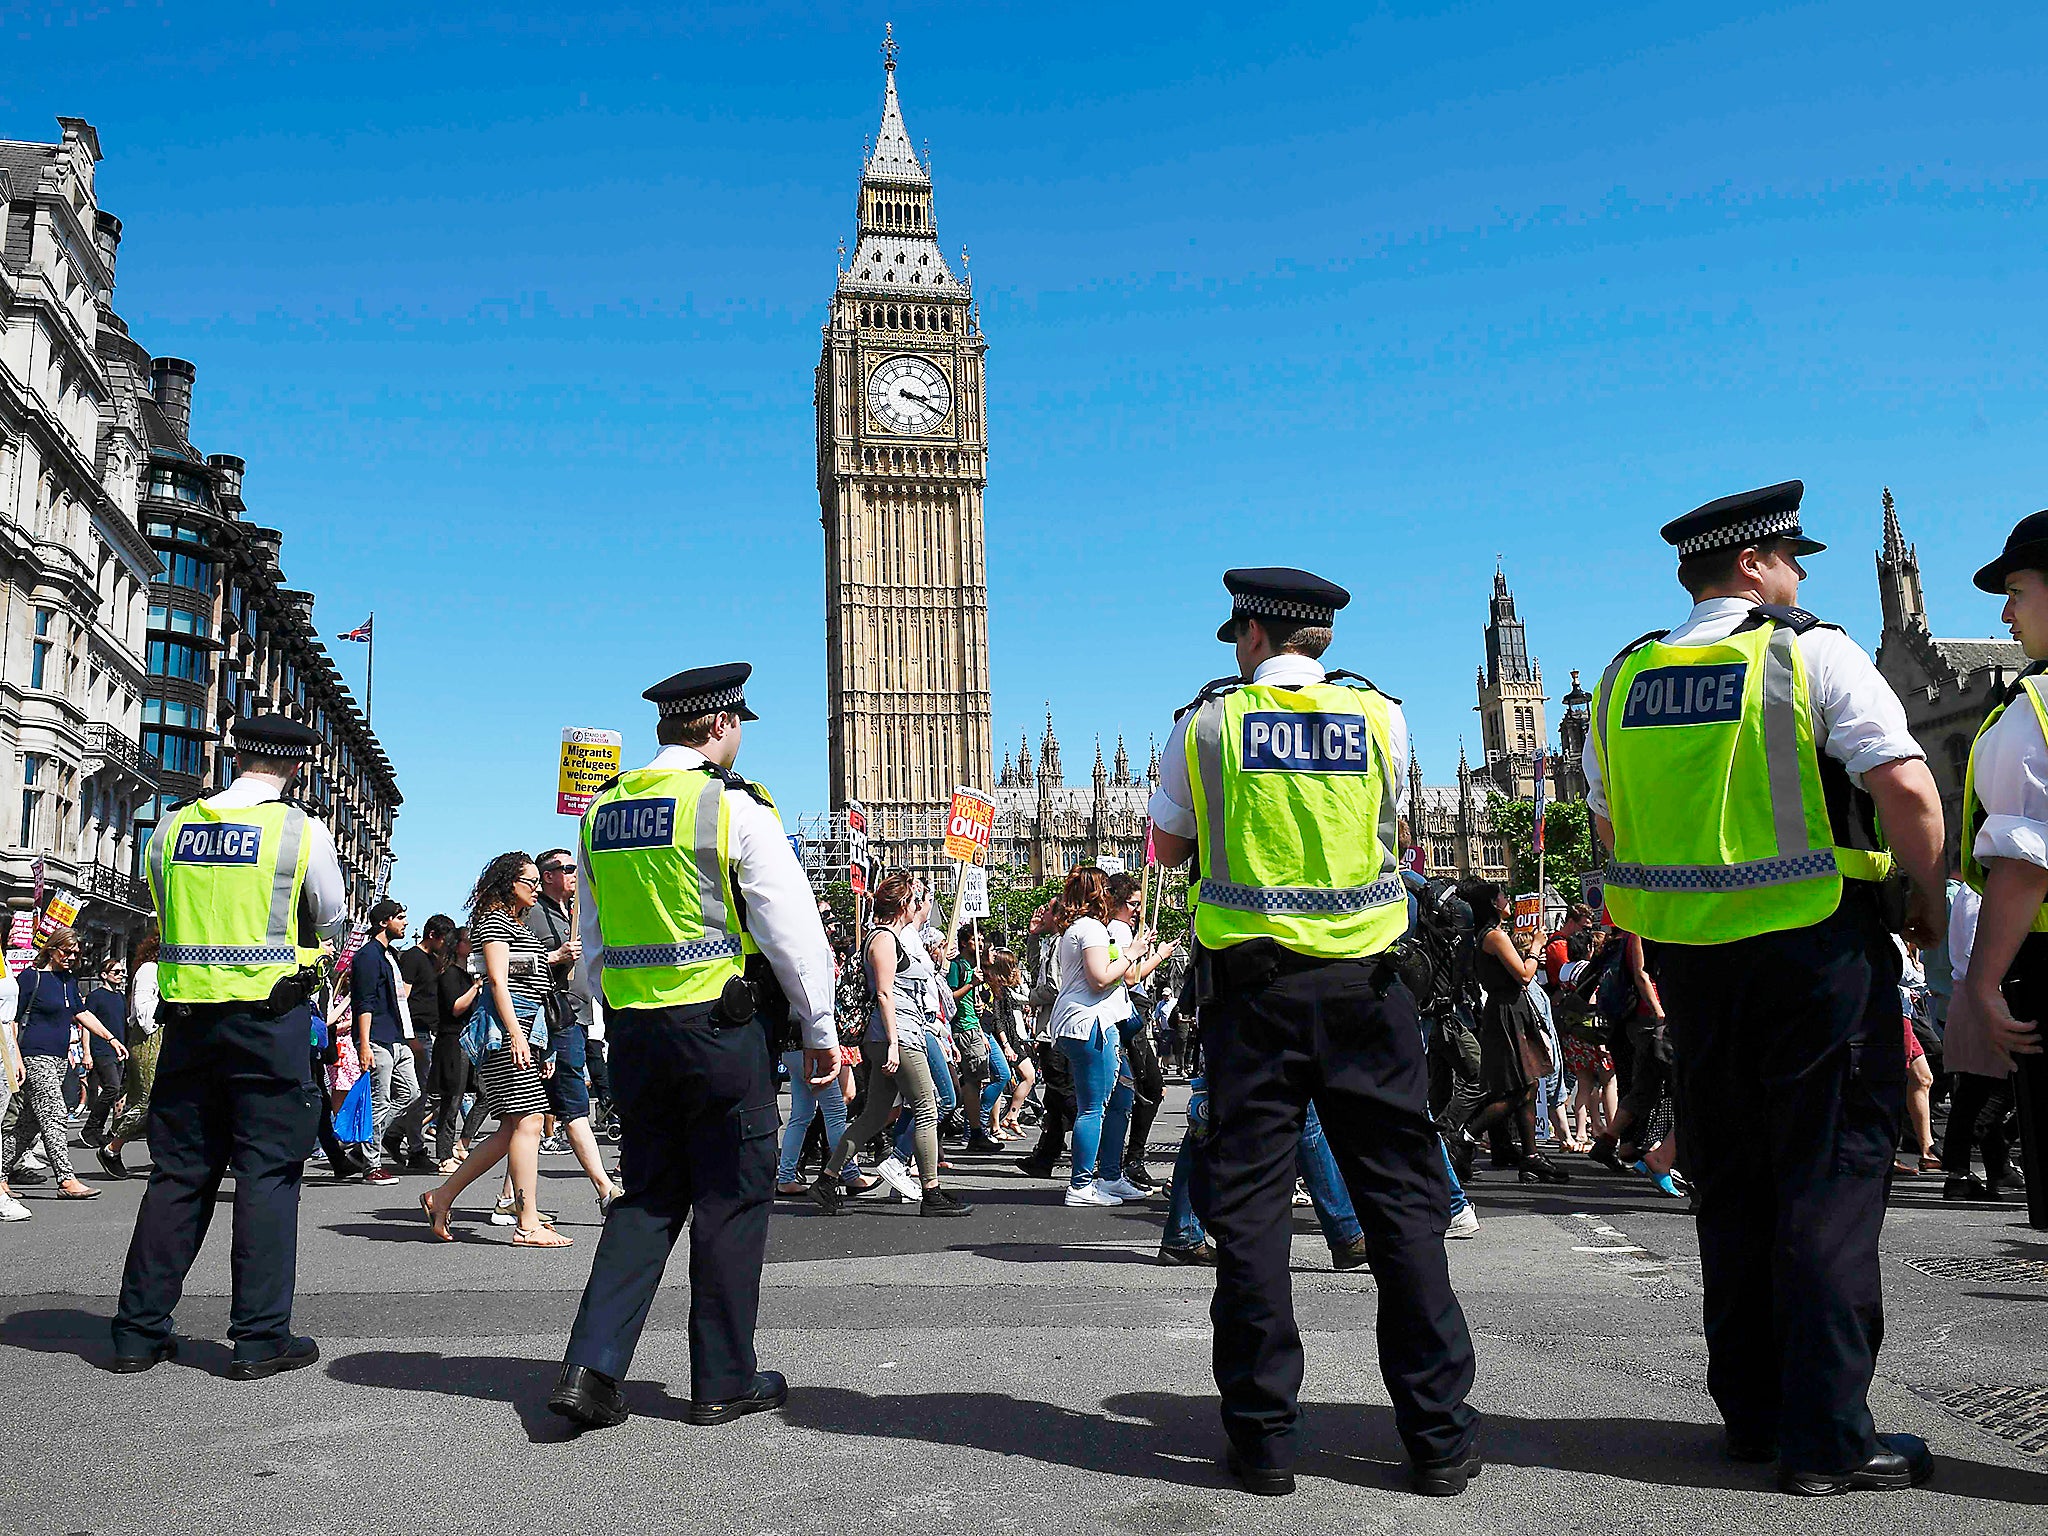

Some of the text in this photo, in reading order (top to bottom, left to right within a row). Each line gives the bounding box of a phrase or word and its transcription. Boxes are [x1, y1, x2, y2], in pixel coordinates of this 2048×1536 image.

[1628, 673, 1737, 717] POLICE
[1250, 721, 1362, 761] POLICE
[567, 745, 613, 759] Migrants
[562, 756, 617, 772] & refugees
[566, 769, 610, 782] welcome
[574, 780, 598, 794] here
[955, 795, 992, 815] KICK THE
[594, 806, 670, 842] POLICE
[954, 804, 991, 827] TORIES
[950, 815, 990, 846] OUT!
[177, 829, 257, 857] POLICE
[1585, 877, 1601, 887] ZONE
[964, 901, 982, 912] OUT
[1516, 912, 1540, 928] OUT
